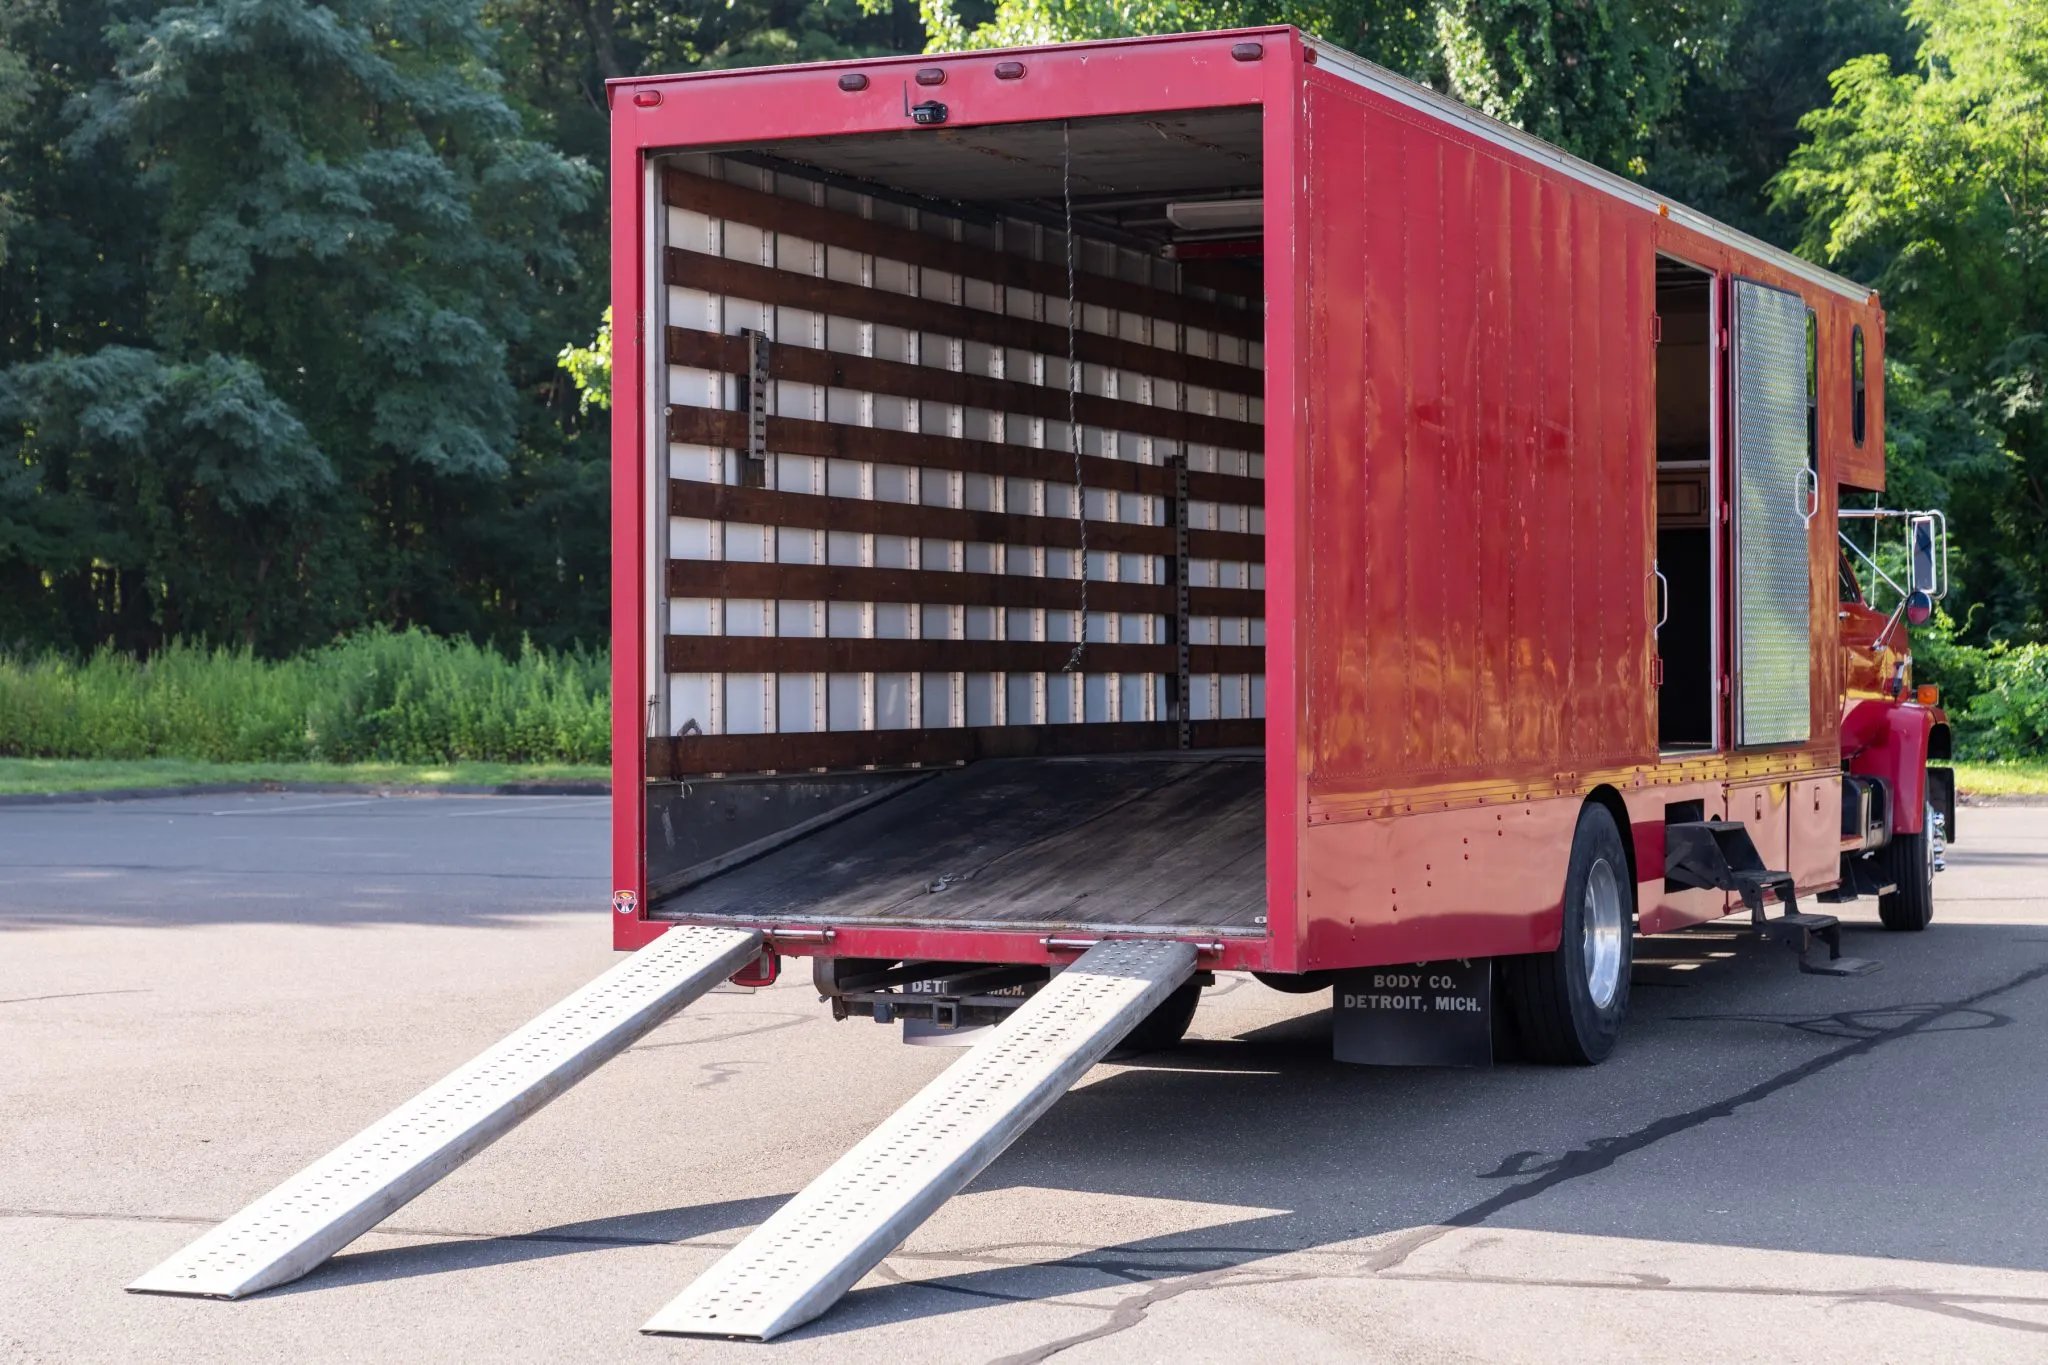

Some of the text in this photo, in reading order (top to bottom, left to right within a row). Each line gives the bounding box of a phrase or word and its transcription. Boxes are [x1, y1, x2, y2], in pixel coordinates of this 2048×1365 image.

[1373, 974, 1457, 989] BODY CO.
[1344, 994, 1481, 1012] DETROIT, MICH.
